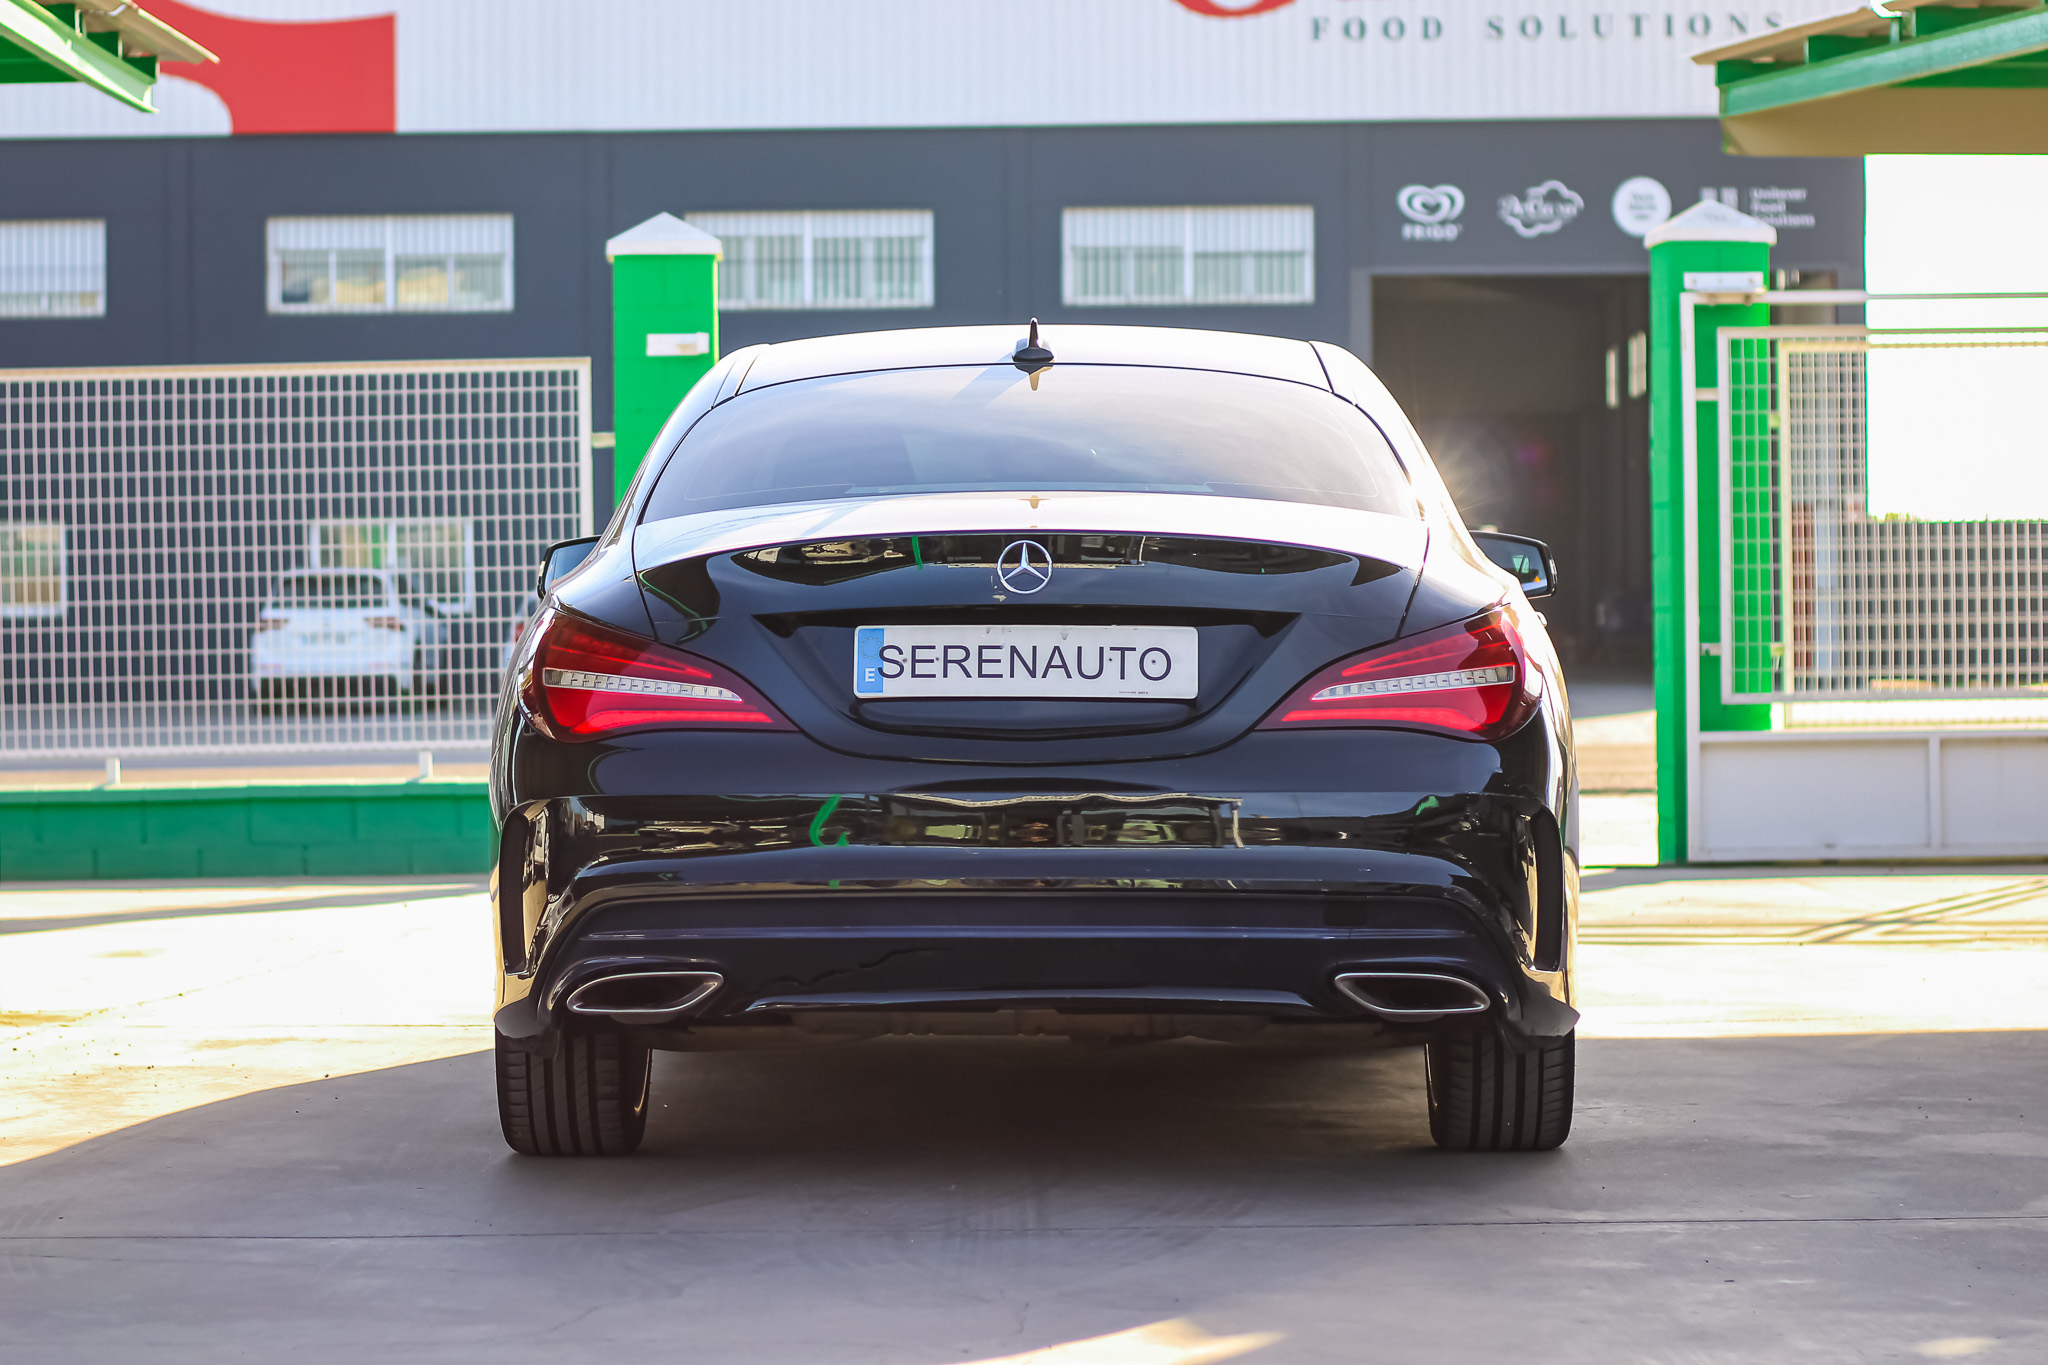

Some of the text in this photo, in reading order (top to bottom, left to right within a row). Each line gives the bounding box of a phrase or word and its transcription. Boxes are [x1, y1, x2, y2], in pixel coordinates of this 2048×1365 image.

[1311, 11, 1783, 41] FOOD SOLUTIONS
[865, 668, 876, 682] E
